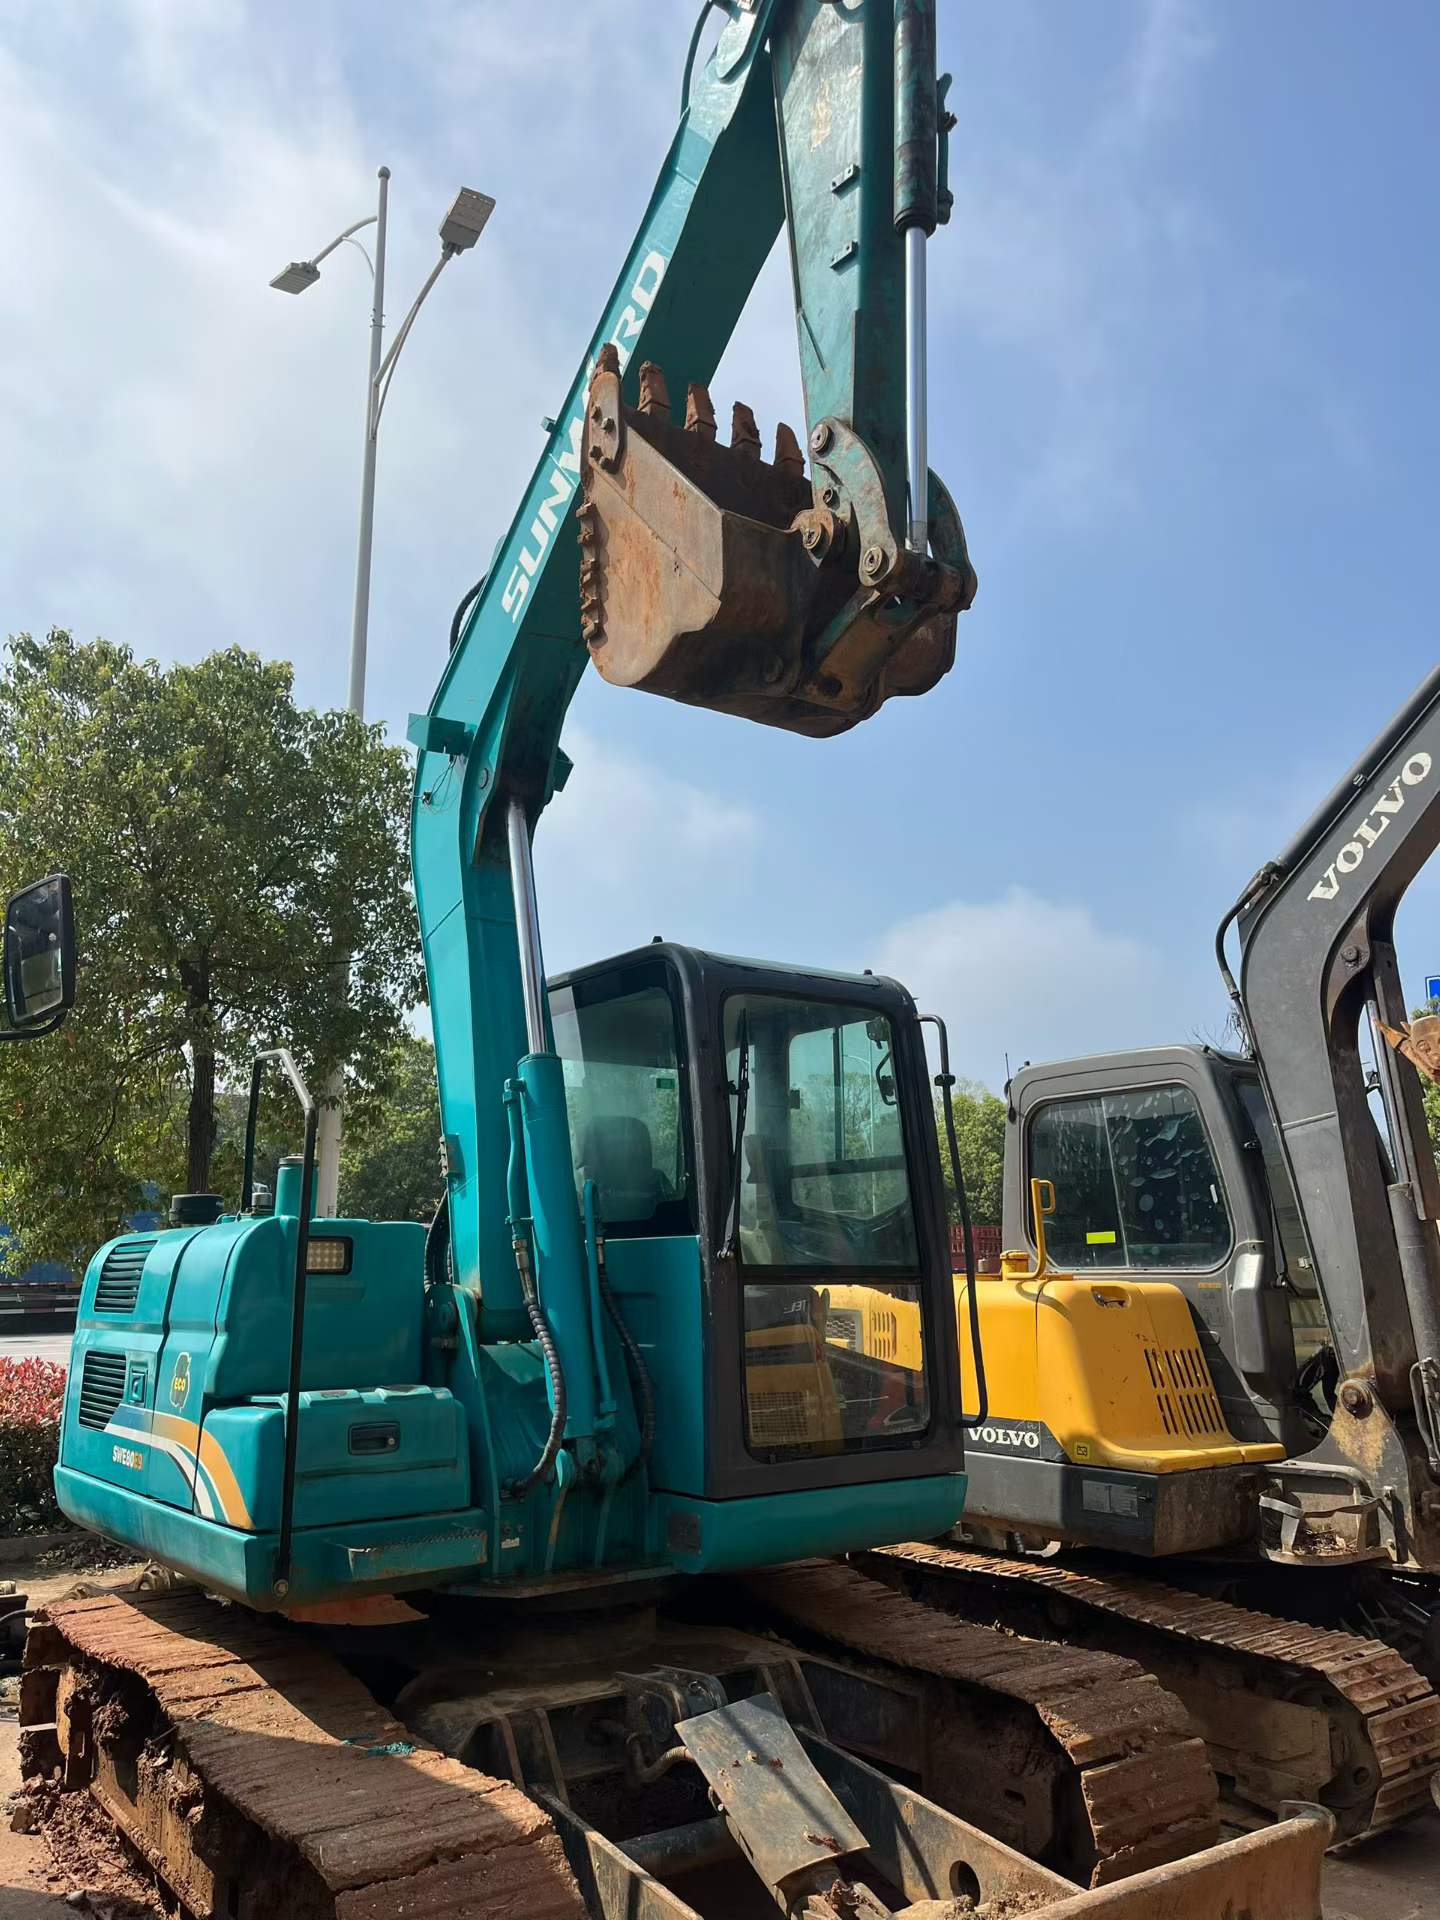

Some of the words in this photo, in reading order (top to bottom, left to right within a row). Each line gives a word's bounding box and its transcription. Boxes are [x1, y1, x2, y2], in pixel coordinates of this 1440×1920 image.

[501, 250, 666, 624] SUNWRD
[1306, 752, 1432, 901] VOLVO
[173, 1376, 186, 1392] ECO
[967, 1425, 1040, 1448] VOLVO
